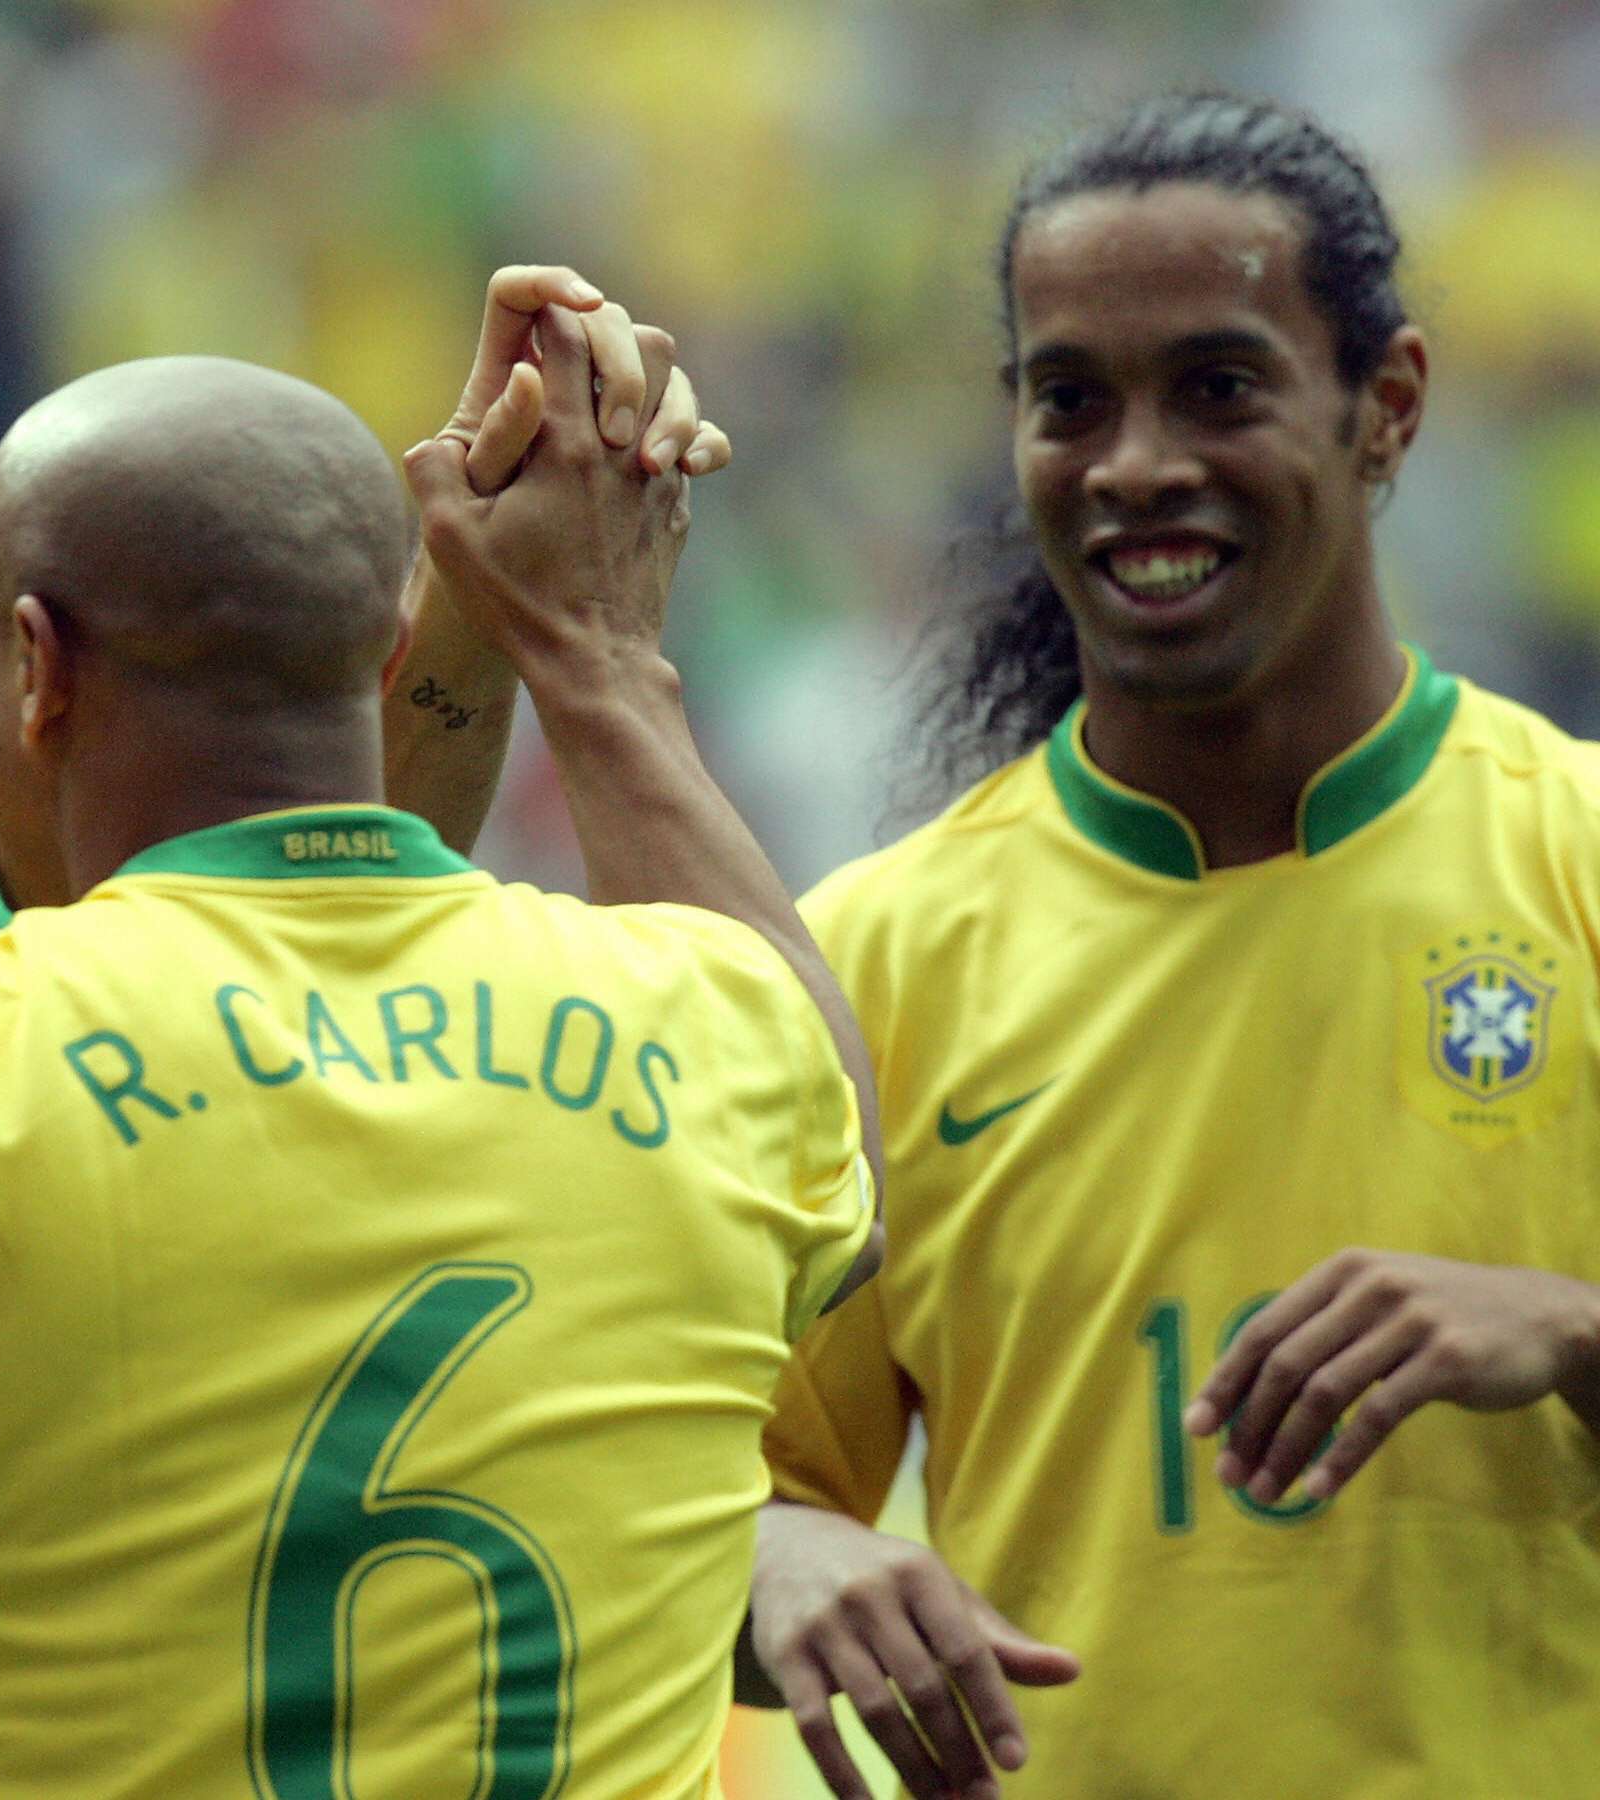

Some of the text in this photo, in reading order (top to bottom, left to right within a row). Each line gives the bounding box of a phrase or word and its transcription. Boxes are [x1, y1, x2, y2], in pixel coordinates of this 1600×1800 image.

[283, 830, 399, 860] BRASIL
[62, 980, 680, 1150] R. CARLOS
[245, 1260, 579, 1800] 6
